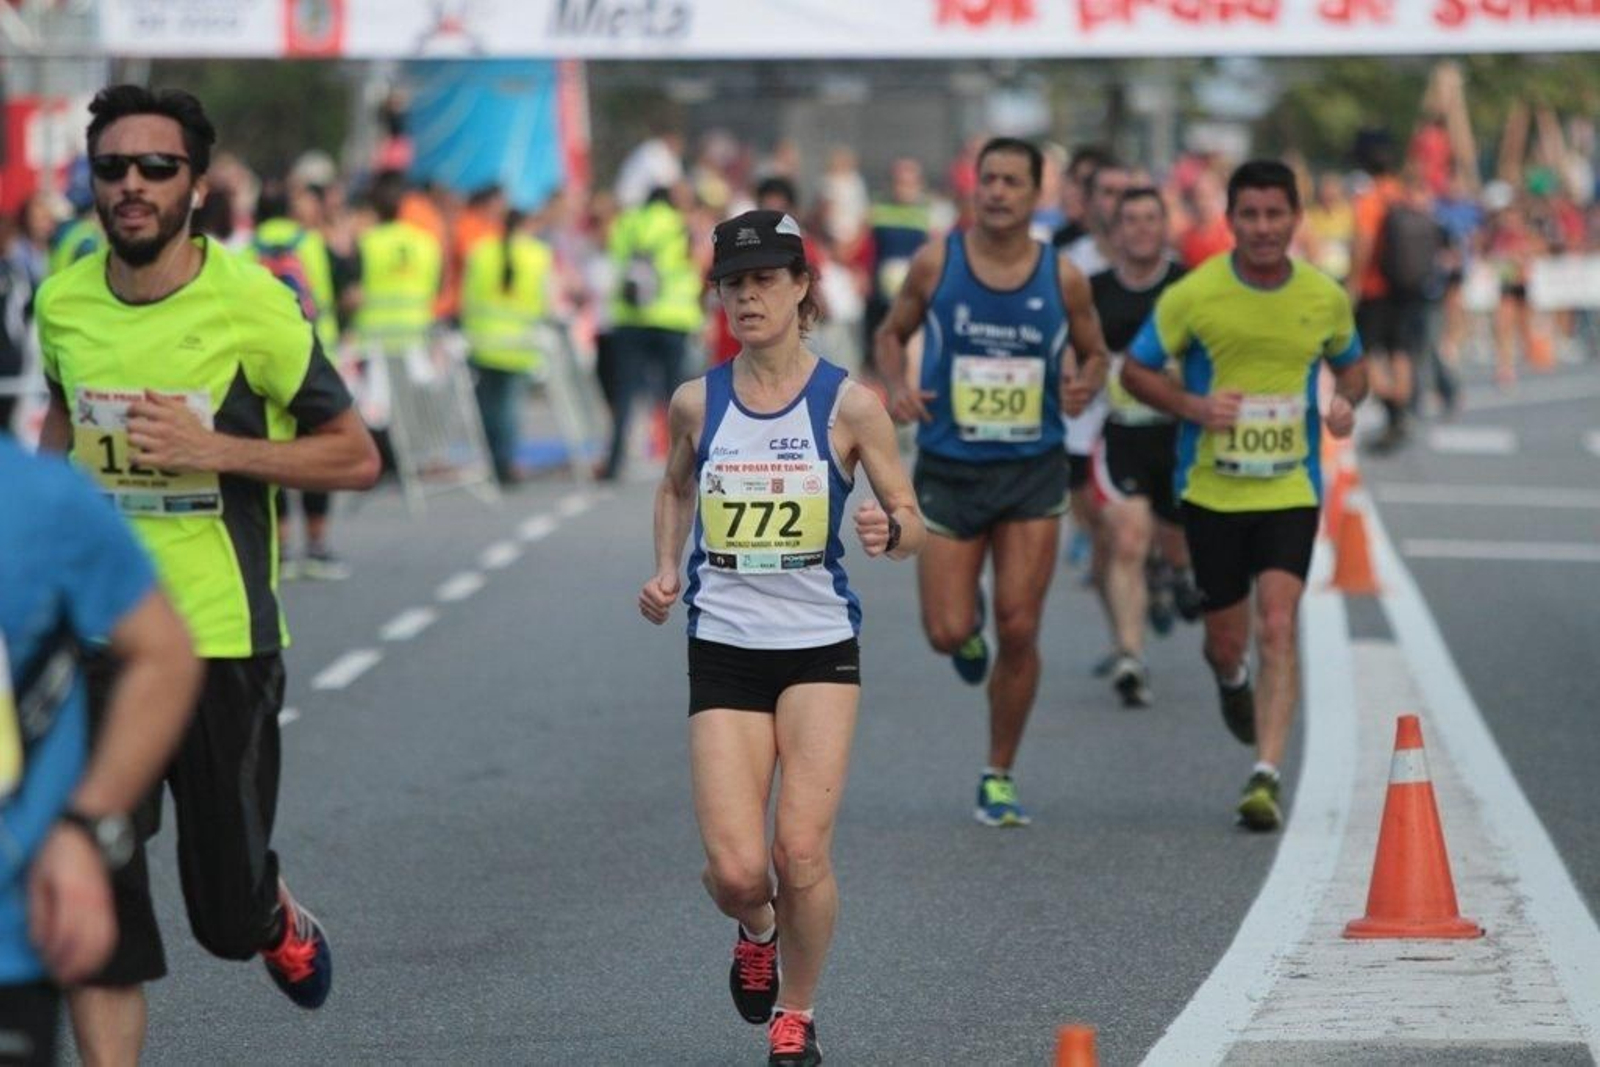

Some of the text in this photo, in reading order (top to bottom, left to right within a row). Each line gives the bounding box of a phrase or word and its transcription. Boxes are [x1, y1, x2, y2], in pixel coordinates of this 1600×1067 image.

[968, 387, 1027, 416] 250
[1225, 425, 1294, 453] 1008
[722, 501, 803, 538] 772
